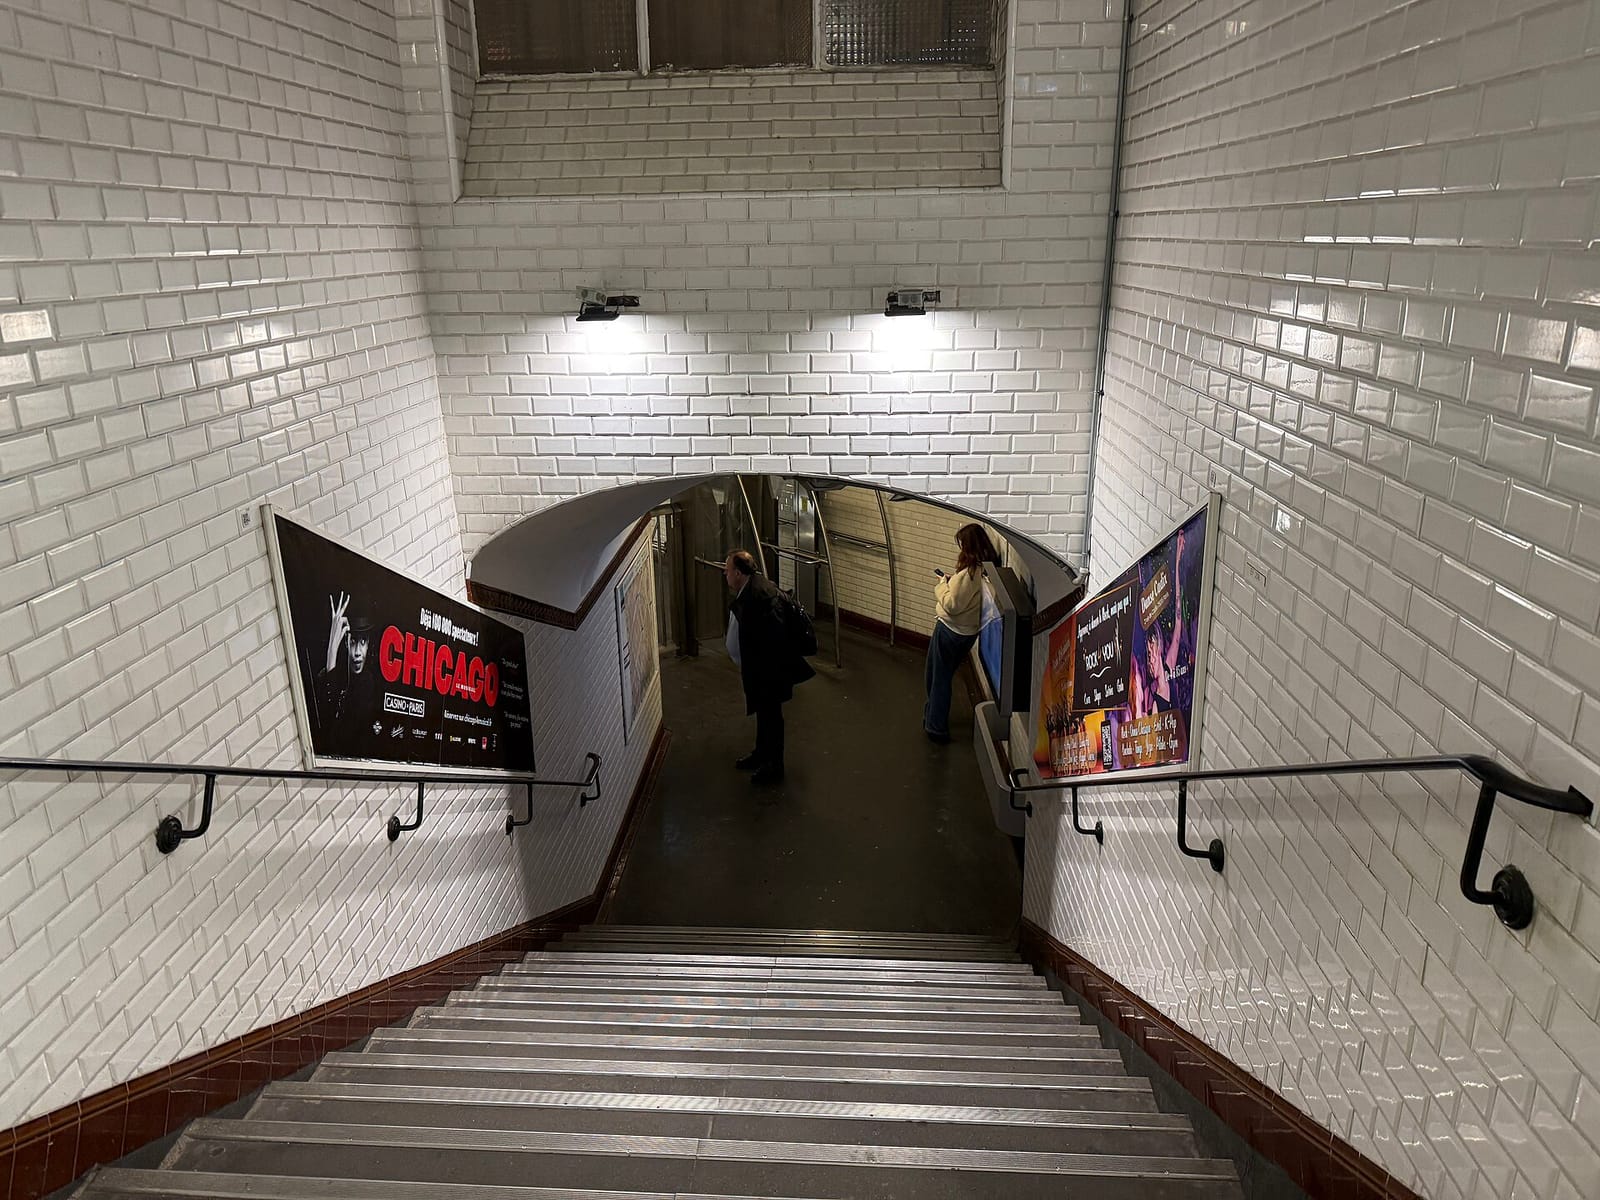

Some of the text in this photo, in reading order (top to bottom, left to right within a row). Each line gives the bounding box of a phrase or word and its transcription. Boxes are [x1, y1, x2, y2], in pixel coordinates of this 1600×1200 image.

[420, 607, 431, 630] Déjà
[432, 612, 441, 632] 100
[1102, 640, 1114, 661] YOU
[380, 625, 498, 707] CHICAGO
[386, 696, 424, 714] CASINO PARIS
